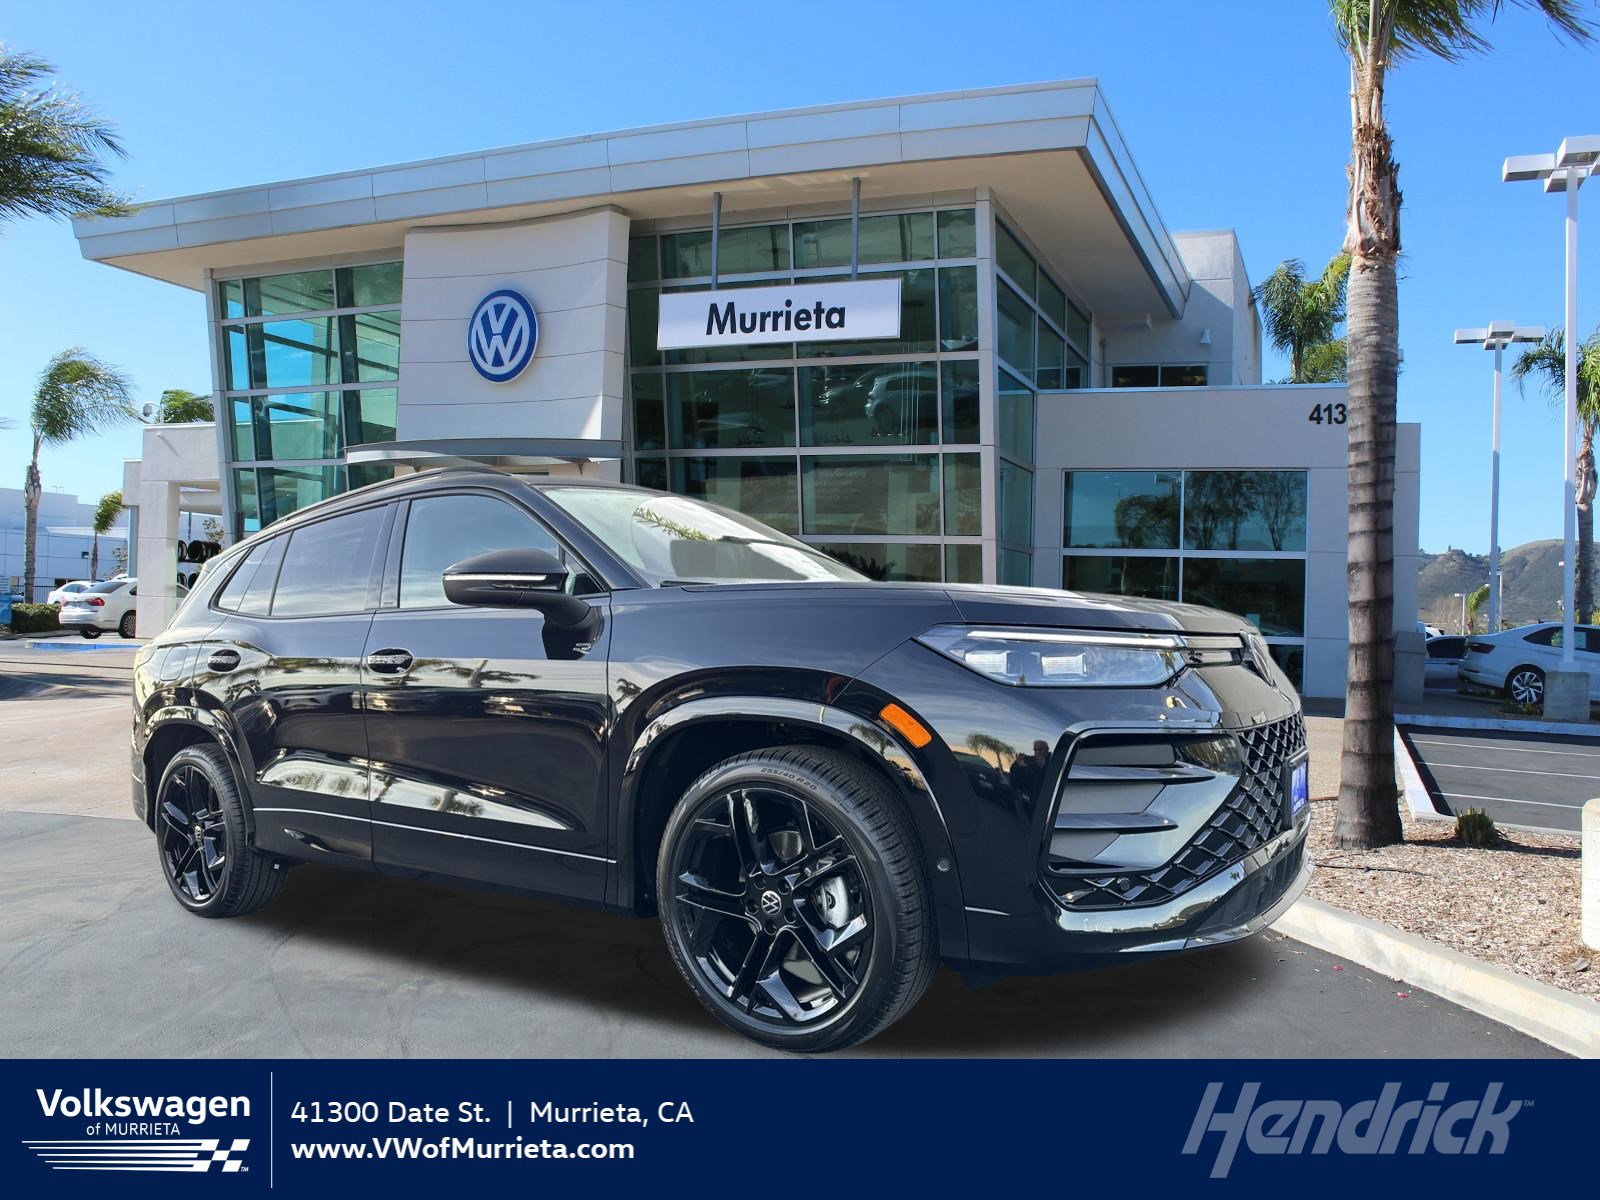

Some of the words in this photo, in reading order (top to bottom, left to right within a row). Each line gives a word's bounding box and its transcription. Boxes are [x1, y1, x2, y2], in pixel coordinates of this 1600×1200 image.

[706, 299, 846, 335] Murrieta
[471, 295, 531, 375] VW
[1309, 404, 1347, 425] 413
[760, 767, 796, 779] 255/40
[796, 777, 818, 791] R20
